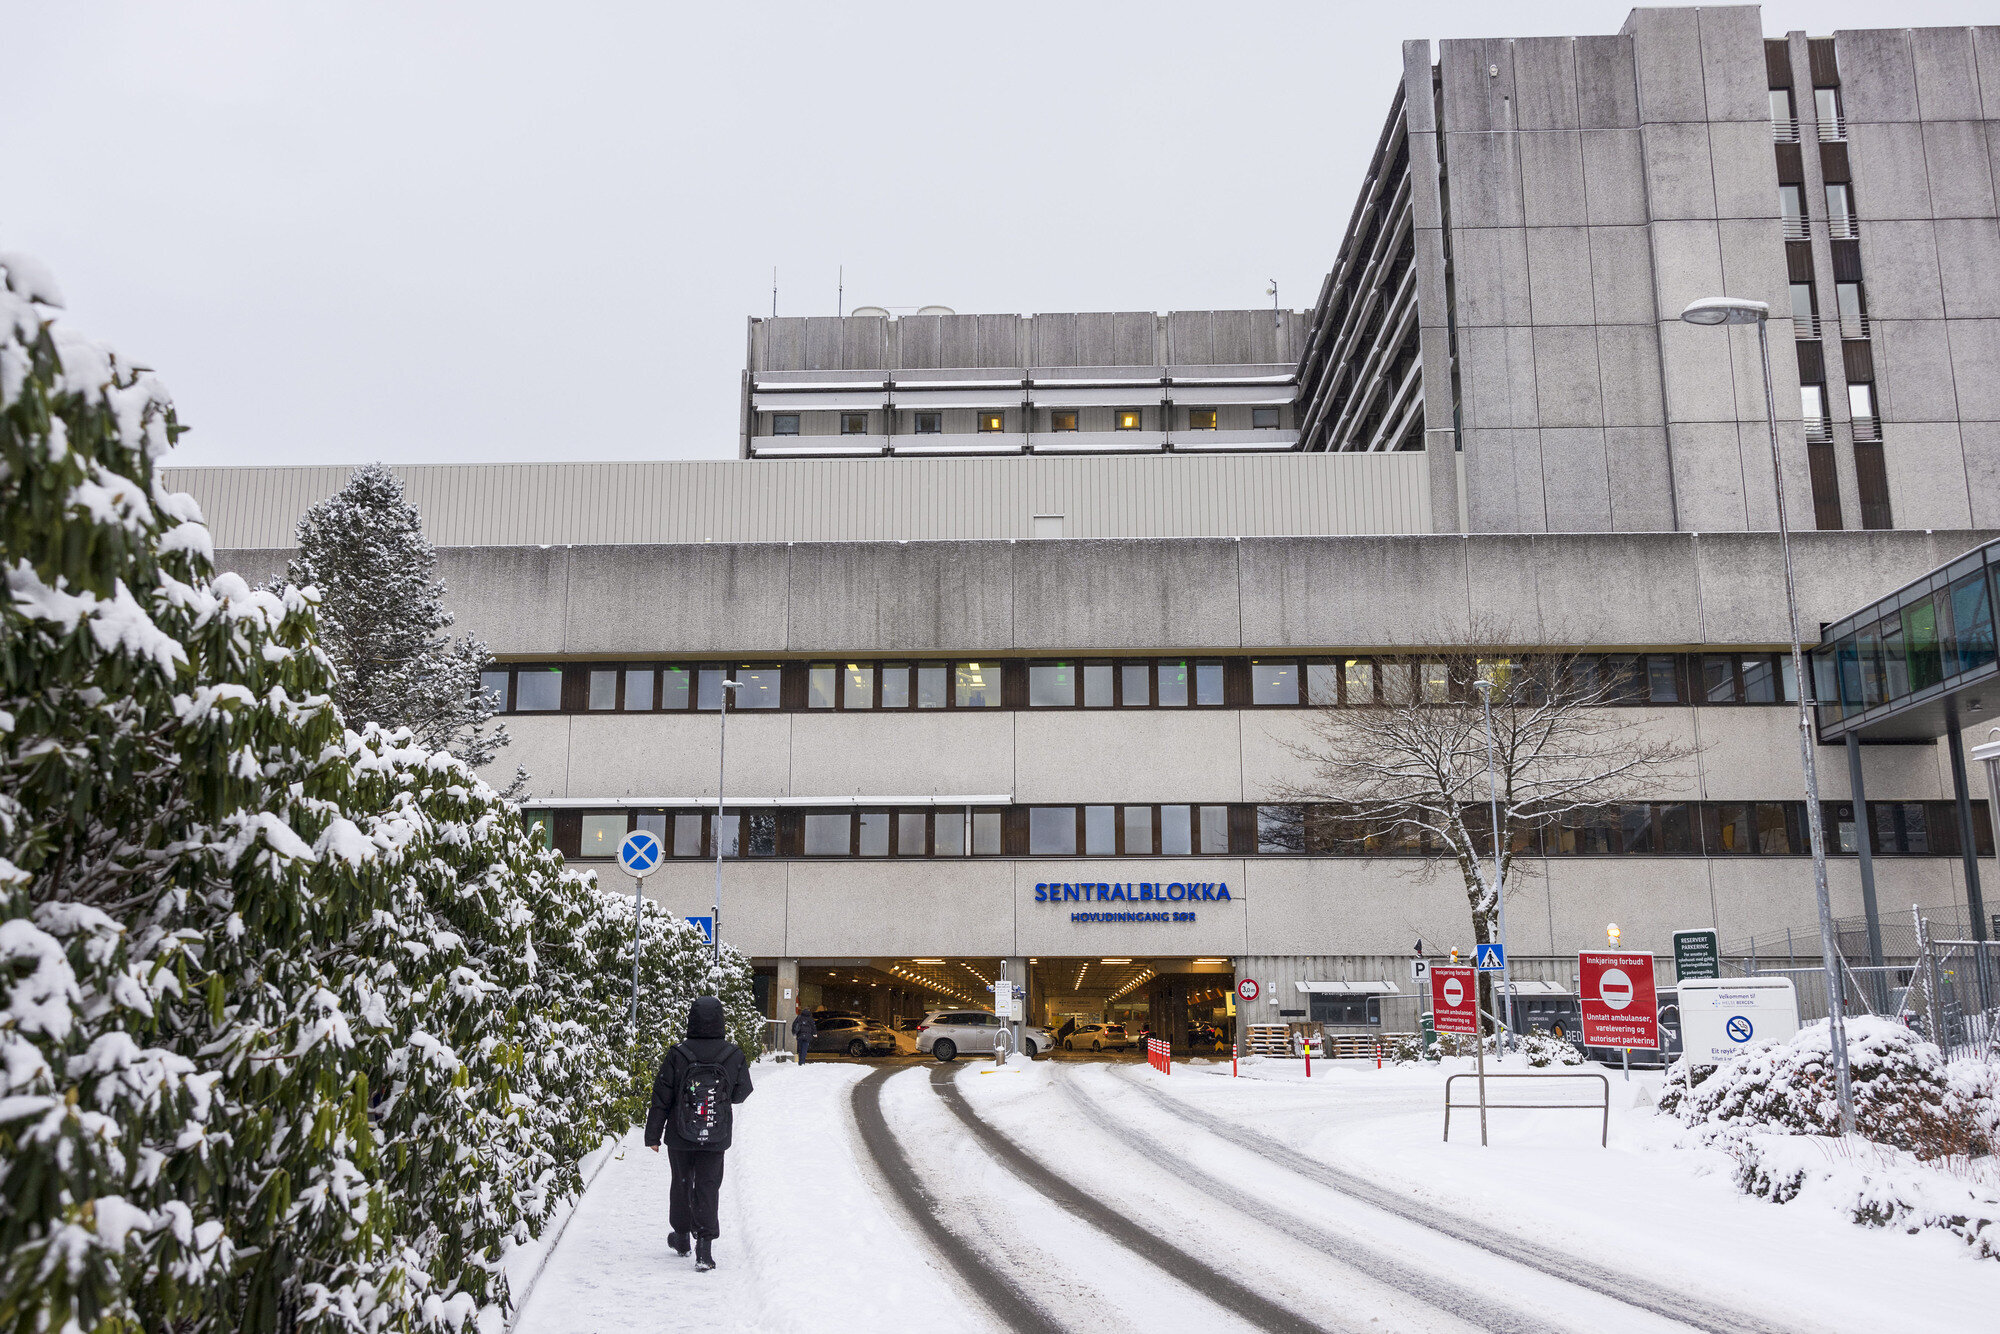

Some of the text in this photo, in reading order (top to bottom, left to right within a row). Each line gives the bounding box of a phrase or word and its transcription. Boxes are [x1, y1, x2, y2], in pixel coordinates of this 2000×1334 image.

[1034, 882, 1231, 901] SENTRALBLOKKA
[1071, 912, 1196, 922] HOVUDINNGANG SØR
[1586, 957, 1644, 966] Innkjøring forbudt
[1416, 962, 1425, 976] P
[1611, 1014, 1652, 1023] ambulanser,
[1596, 1025, 1636, 1034] varelevering
[1590, 1035, 1655, 1046] autorisert parkering
